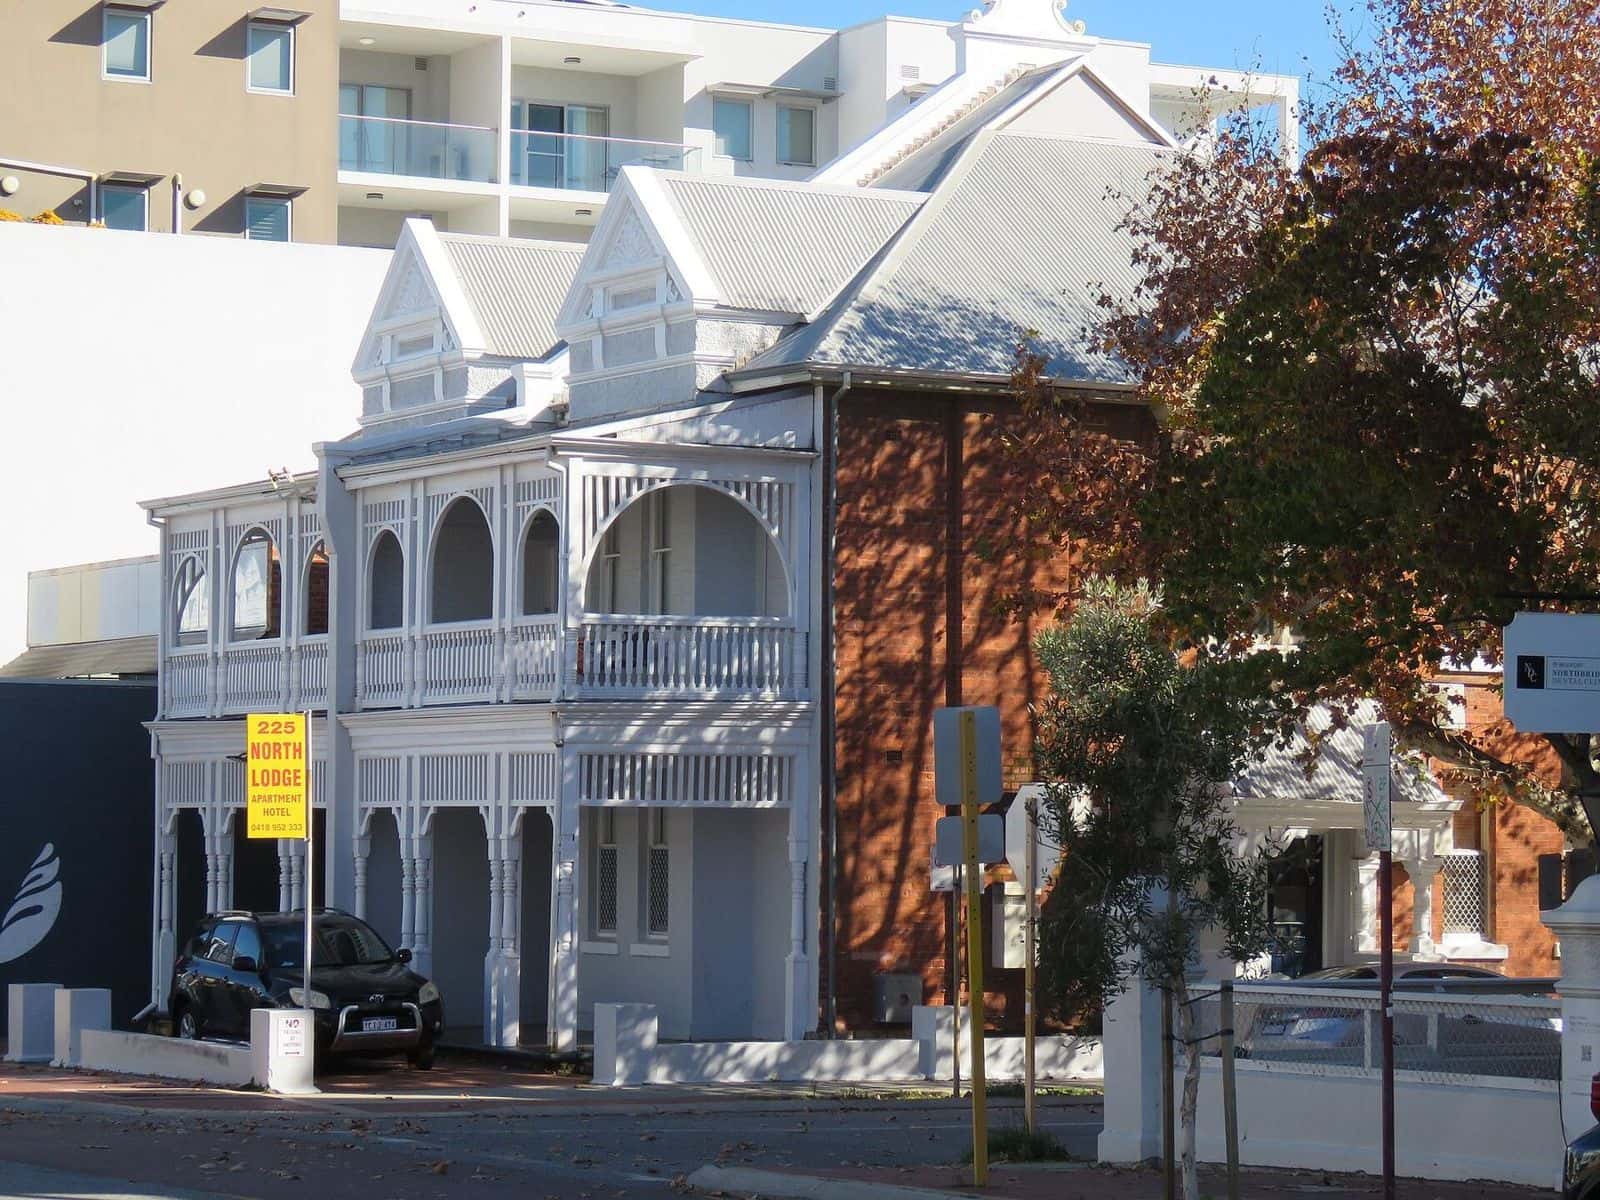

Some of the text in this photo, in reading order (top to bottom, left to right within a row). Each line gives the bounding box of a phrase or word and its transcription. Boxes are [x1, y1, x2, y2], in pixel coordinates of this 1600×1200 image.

[257, 721, 296, 734] 225
[250, 742, 303, 760] NORTH
[252, 769, 302, 787] LODGE
[251, 794, 303, 804] APARTMENT
[263, 808, 292, 817] HOTEL
[286, 1019, 300, 1028] NO
